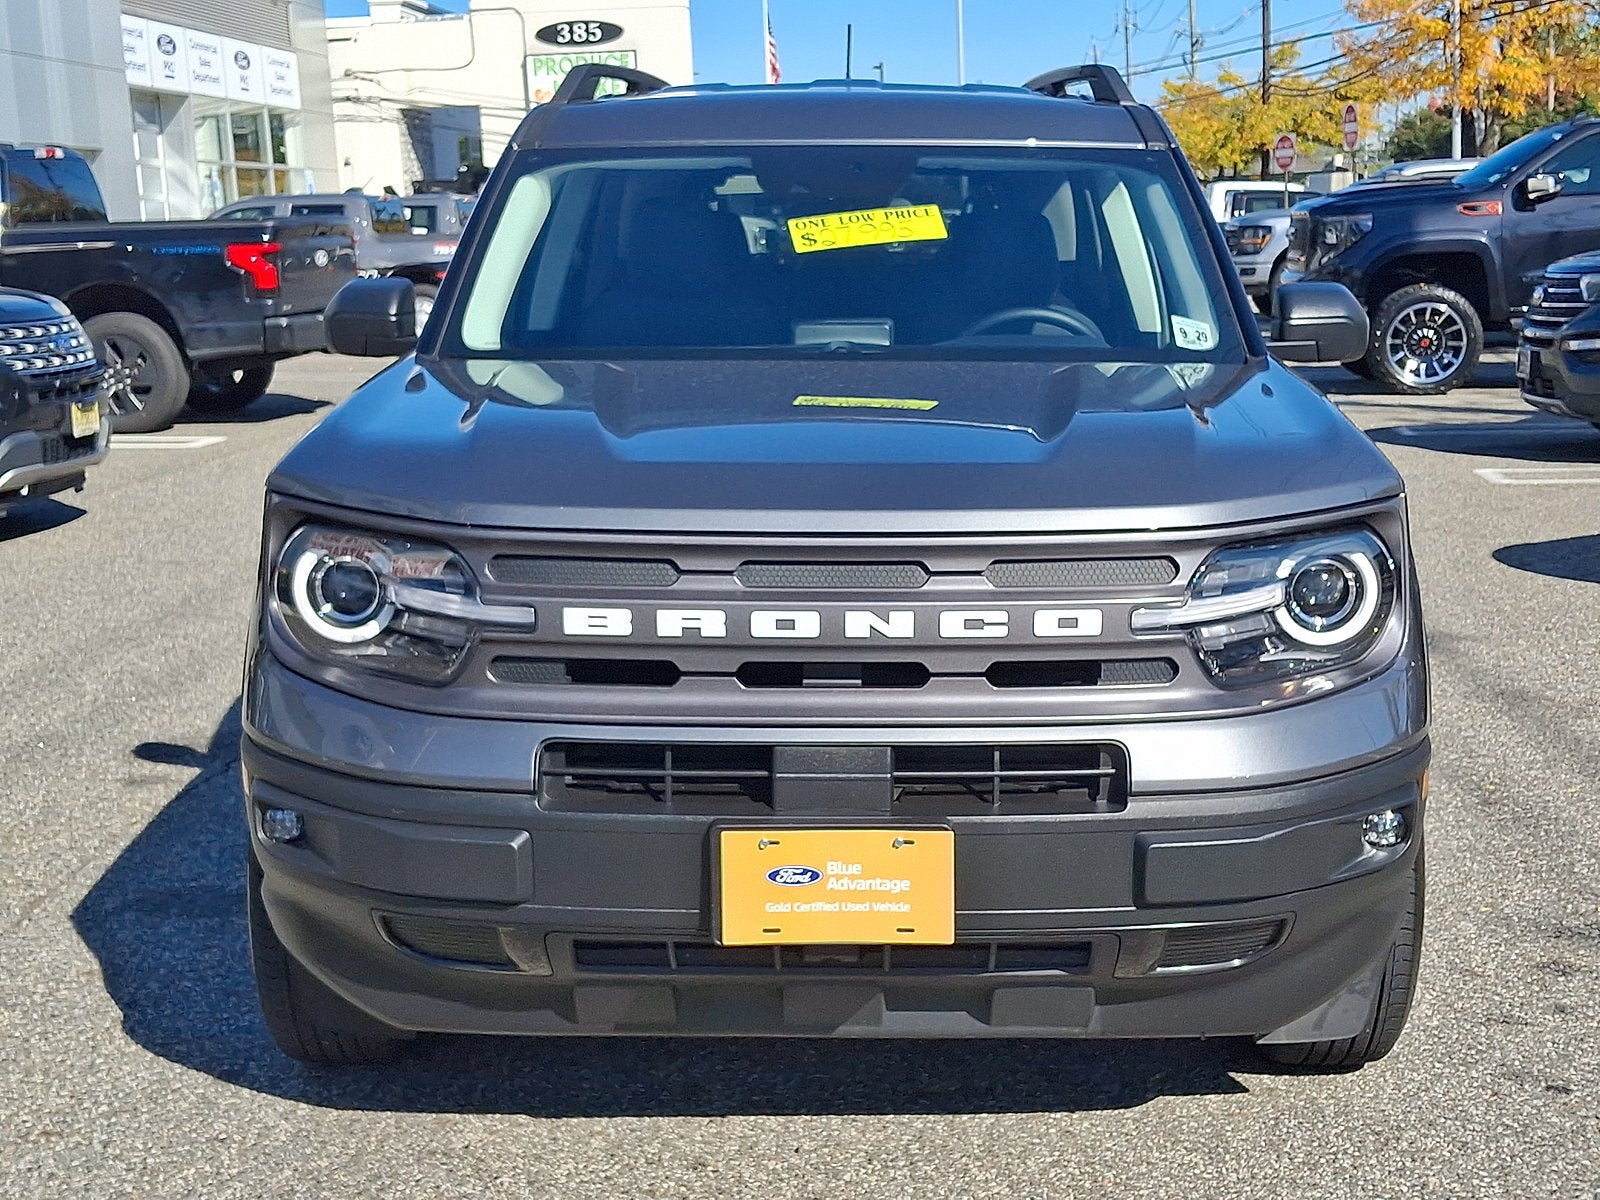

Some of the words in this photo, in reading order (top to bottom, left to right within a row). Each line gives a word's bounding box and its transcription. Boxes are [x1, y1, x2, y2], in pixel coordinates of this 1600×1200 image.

[556, 22, 603, 44] 385
[795, 218, 831, 231] ONE
[839, 213, 875, 225] LOW
[884, 208, 936, 221] PRICE
[563, 606, 1103, 639] BRONCO
[773, 867, 813, 885] Ford
[826, 861, 862, 876] Blue
[826, 877, 911, 894] Advantage
[765, 902, 792, 913] Gold
[793, 901, 839, 913] Certified
[842, 902, 870, 912] Used
[872, 902, 911, 913] Vehicle
